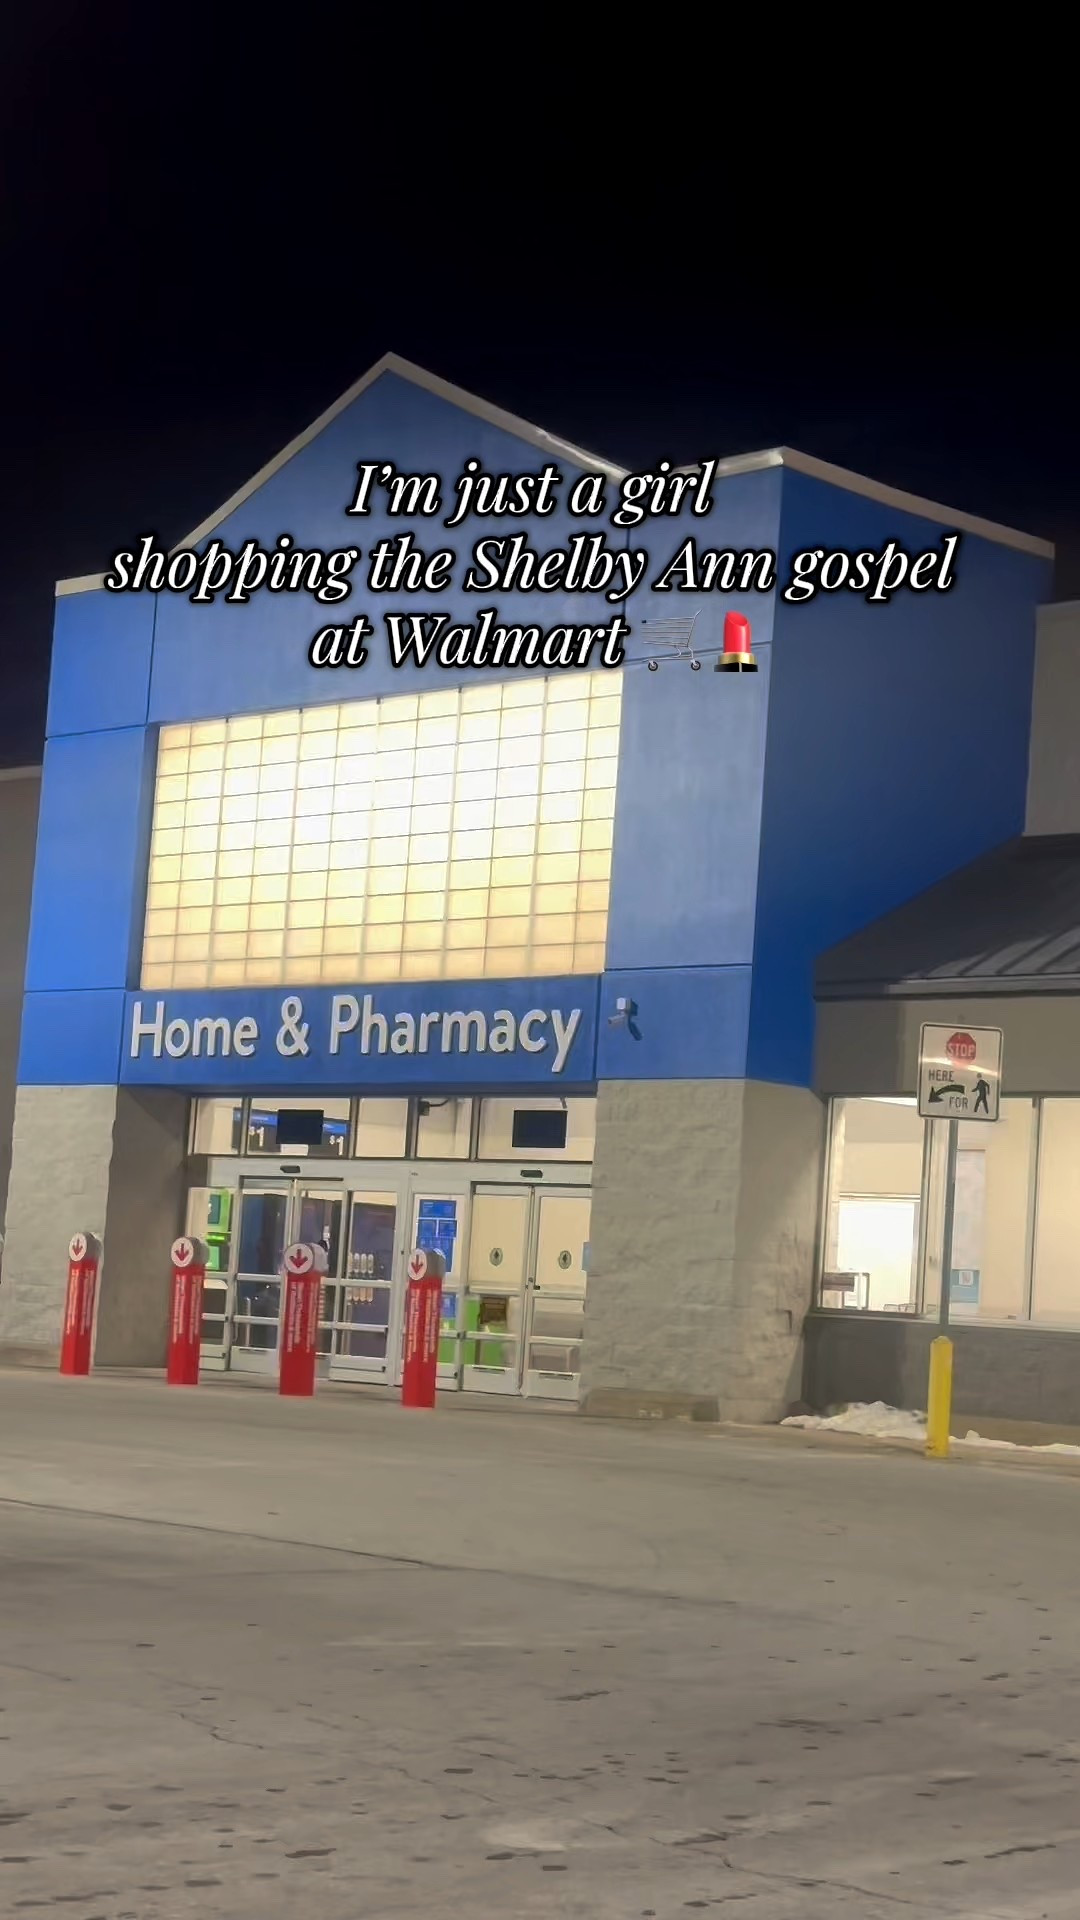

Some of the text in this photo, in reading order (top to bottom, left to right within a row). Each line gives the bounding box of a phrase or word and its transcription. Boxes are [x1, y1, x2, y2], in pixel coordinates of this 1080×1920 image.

[130, 994, 582, 1073] Home & Pharmacy
[947, 1042, 976, 1057] STOP
[928, 1069, 955, 1083] HERE
[949, 1096, 969, 1110] FOR
